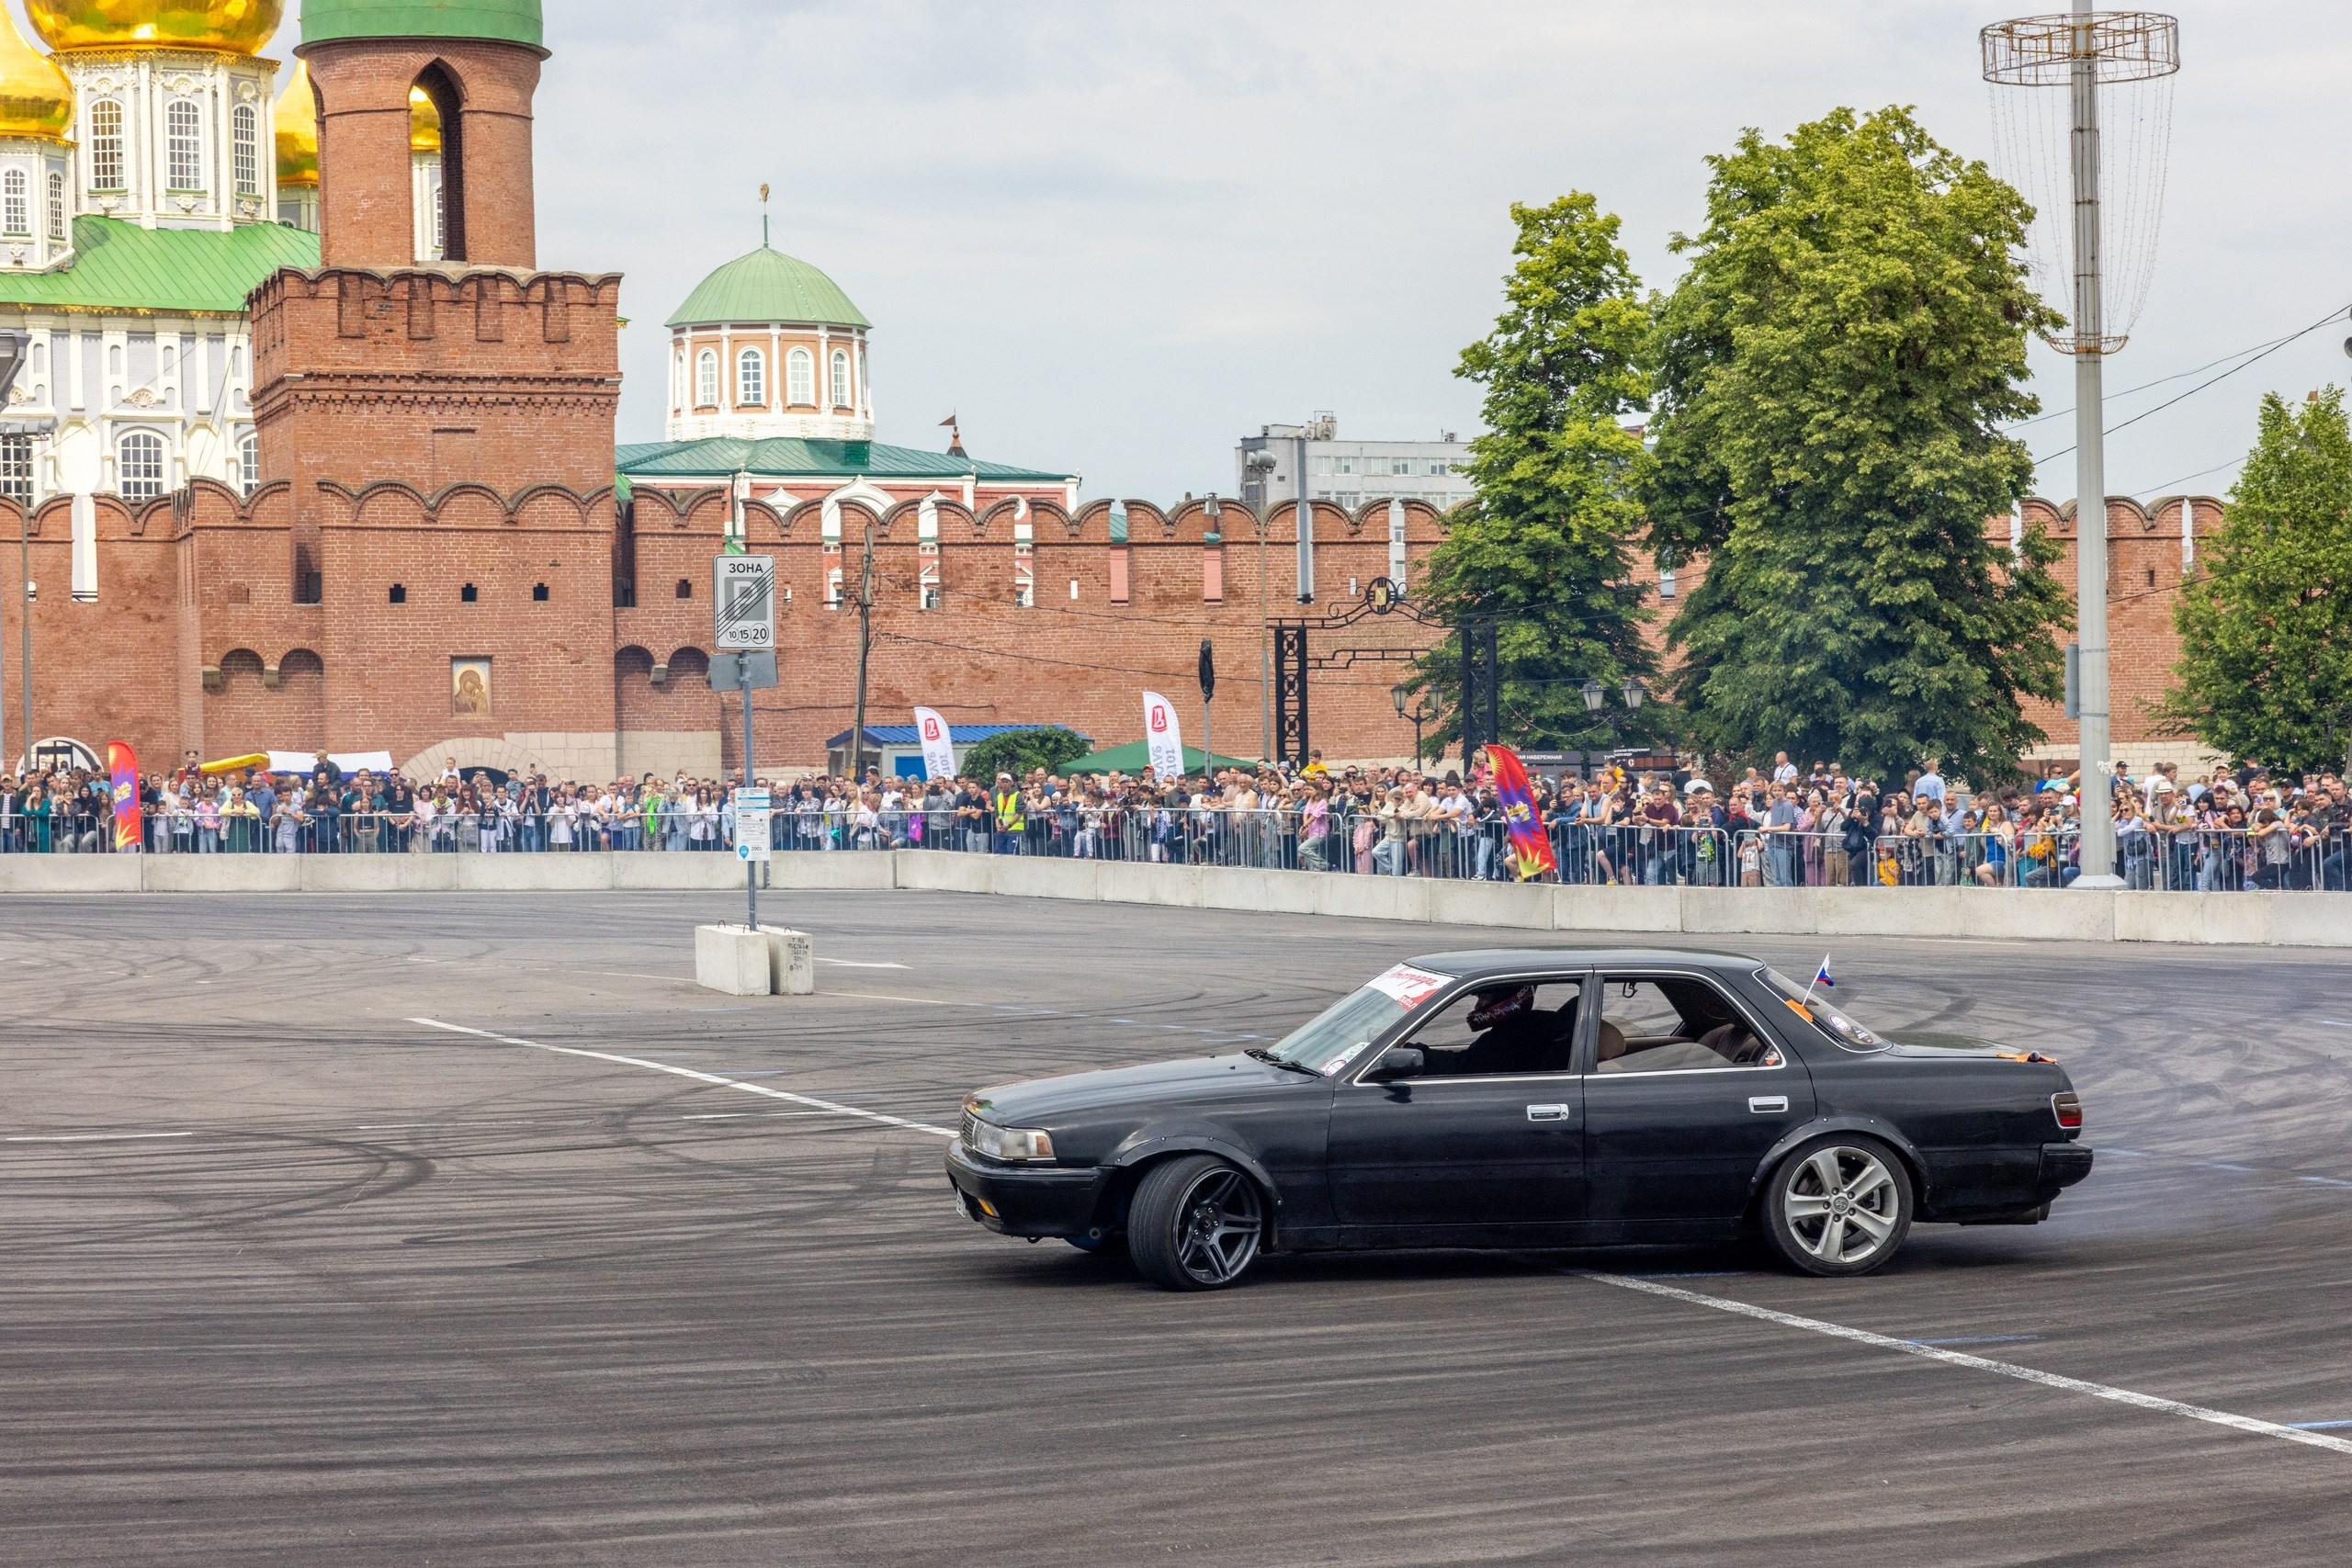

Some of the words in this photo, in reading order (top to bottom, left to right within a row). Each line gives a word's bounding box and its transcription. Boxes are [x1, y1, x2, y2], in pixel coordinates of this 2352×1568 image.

[729, 563, 763, 573] ЗОНА
[729, 630, 737, 638] 10
[741, 629, 749, 638] 15
[752, 628, 767, 639] 20
